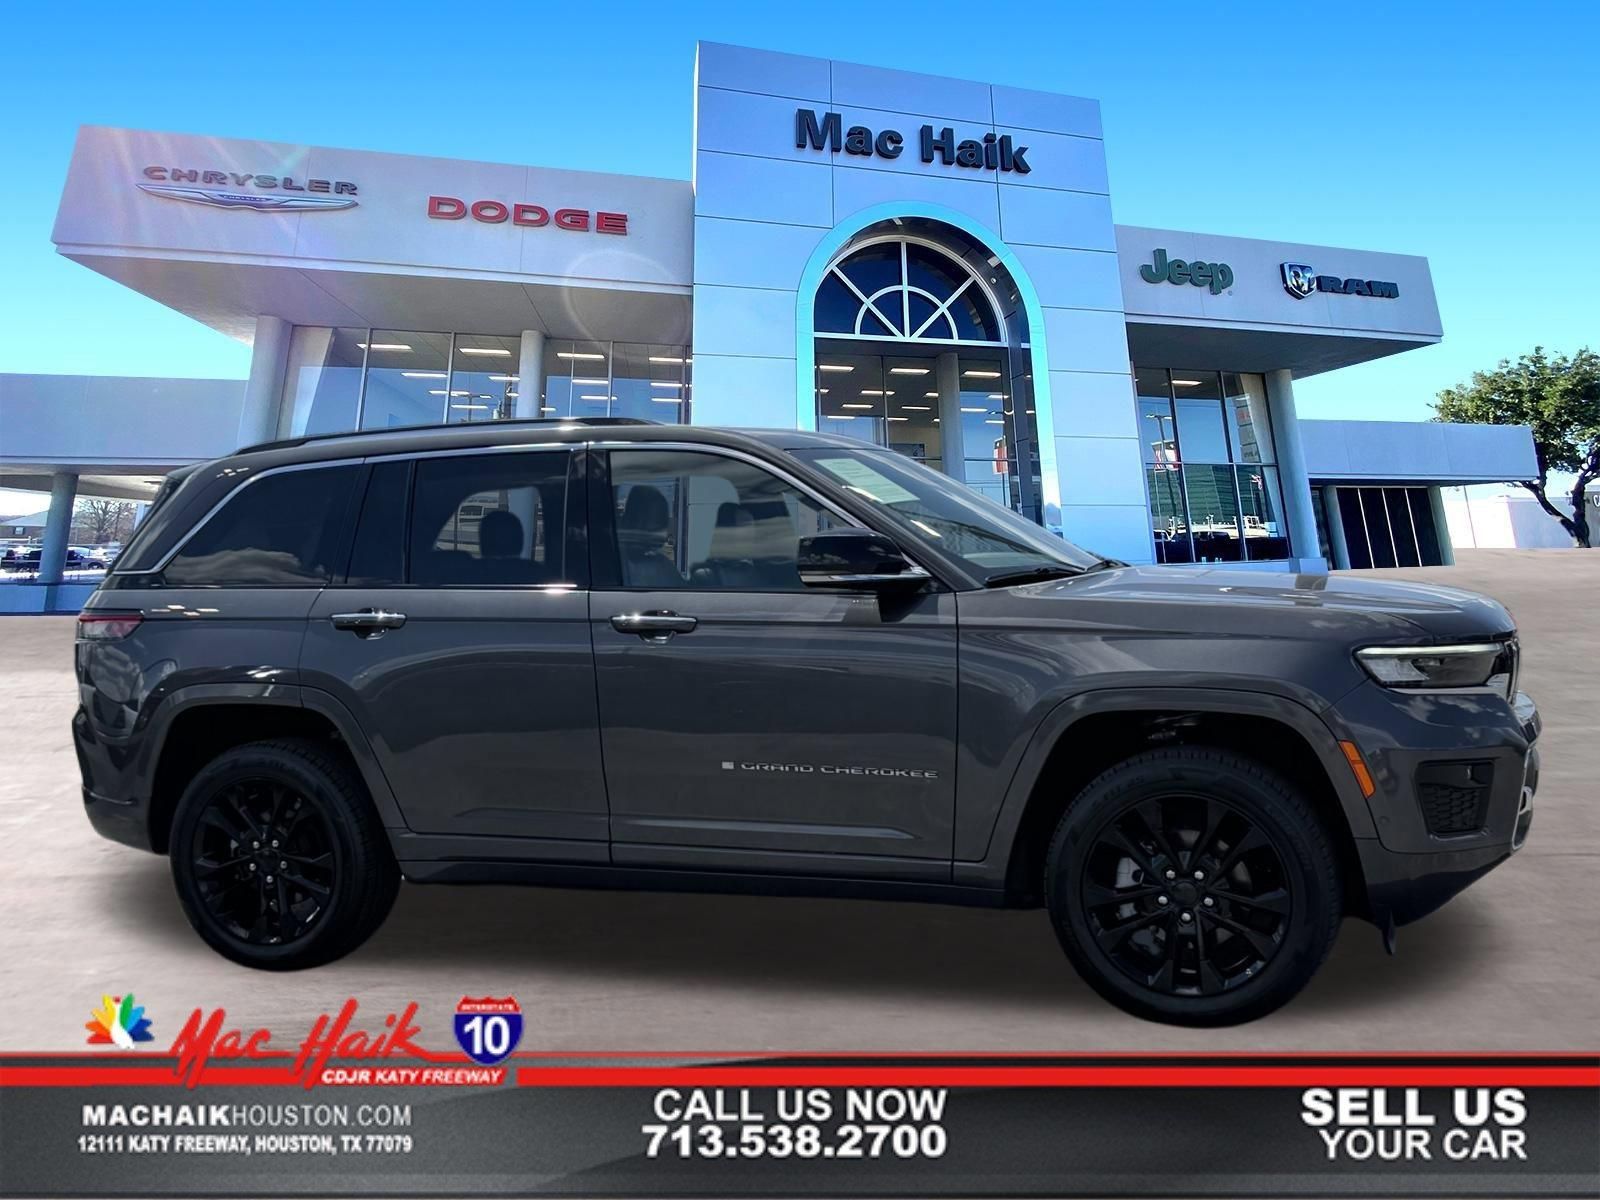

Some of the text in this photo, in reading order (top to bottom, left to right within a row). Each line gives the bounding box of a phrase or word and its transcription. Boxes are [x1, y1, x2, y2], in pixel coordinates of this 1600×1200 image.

[795, 108, 1032, 174] Mac Haik
[143, 165, 359, 197] CHRYSLER
[427, 195, 628, 236] DODGE
[1140, 248, 1234, 296] Jeep
[1315, 275, 1400, 299] RAM
[740, 762, 939, 779] GRAND CHEROKEE
